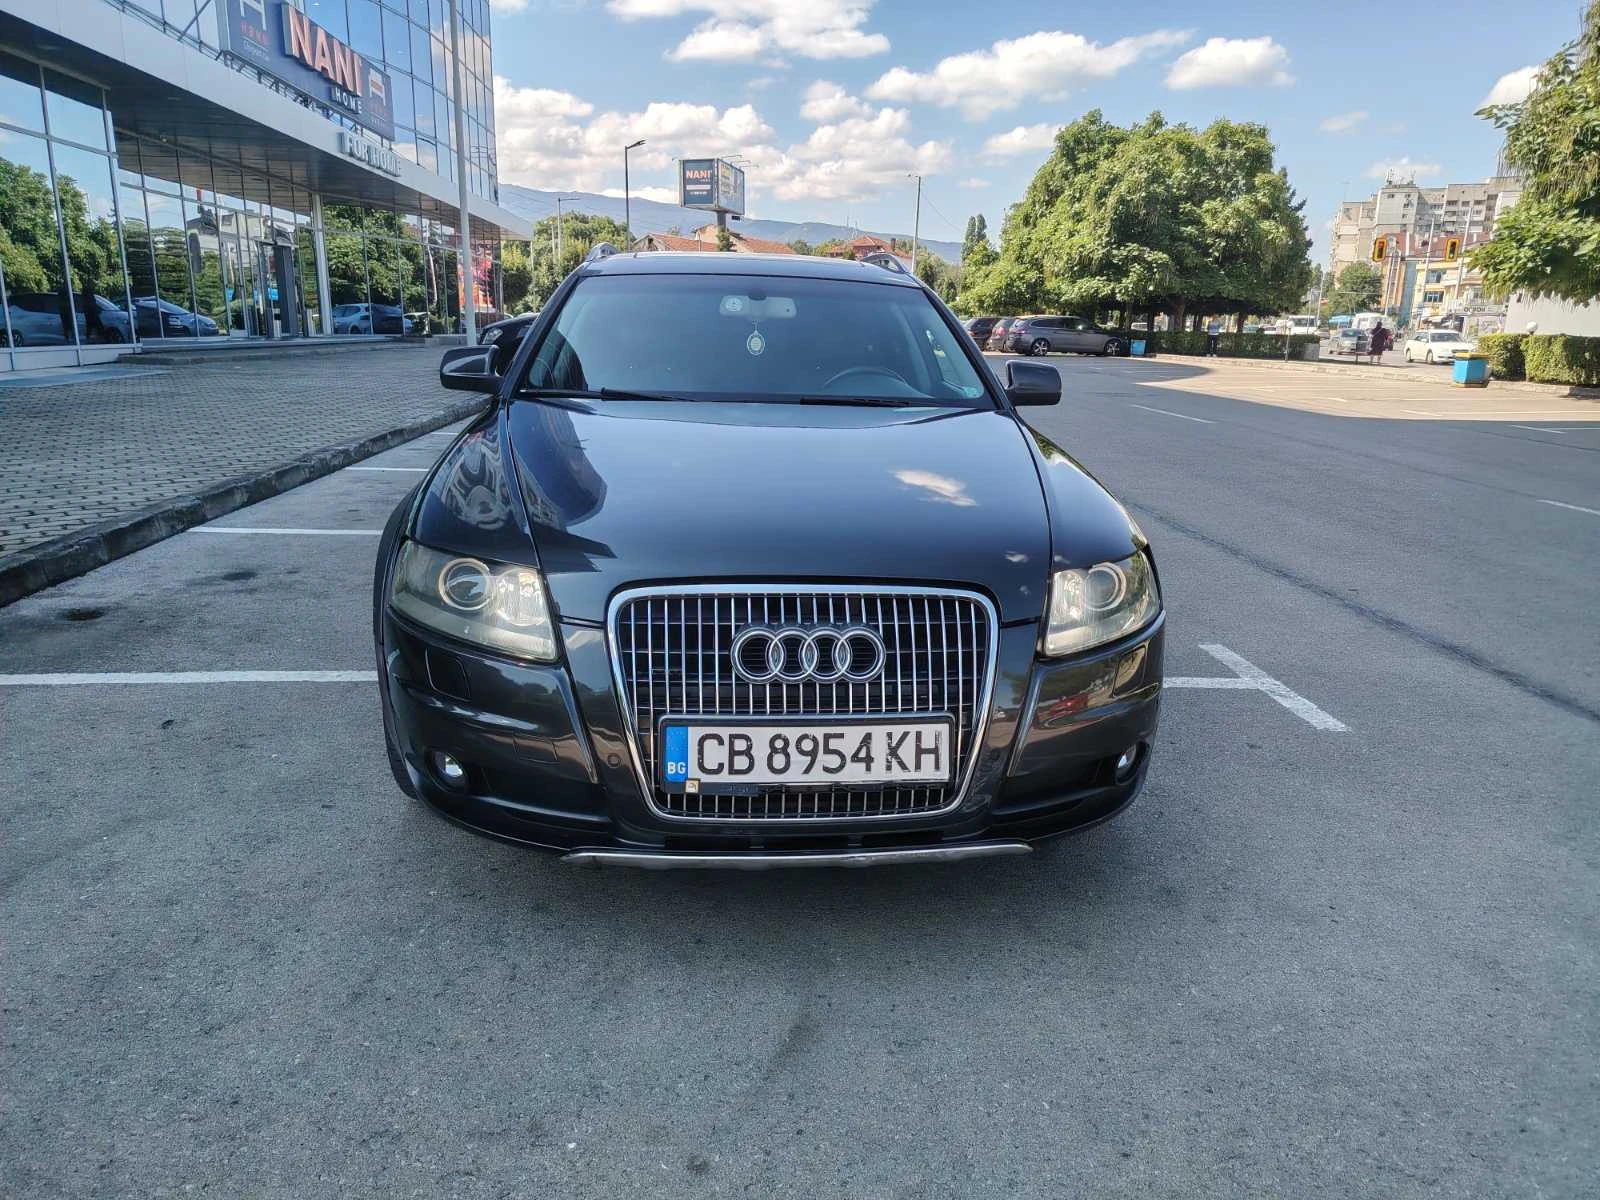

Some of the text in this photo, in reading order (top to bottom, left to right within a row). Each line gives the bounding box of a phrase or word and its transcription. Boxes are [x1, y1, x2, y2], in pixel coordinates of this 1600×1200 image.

[289, 5, 363, 97] NANI
[335, 88, 363, 115] HOME
[686, 170, 710, 178] NANI
[766, 731, 875, 776] 8954
[667, 761, 687, 775] BG
